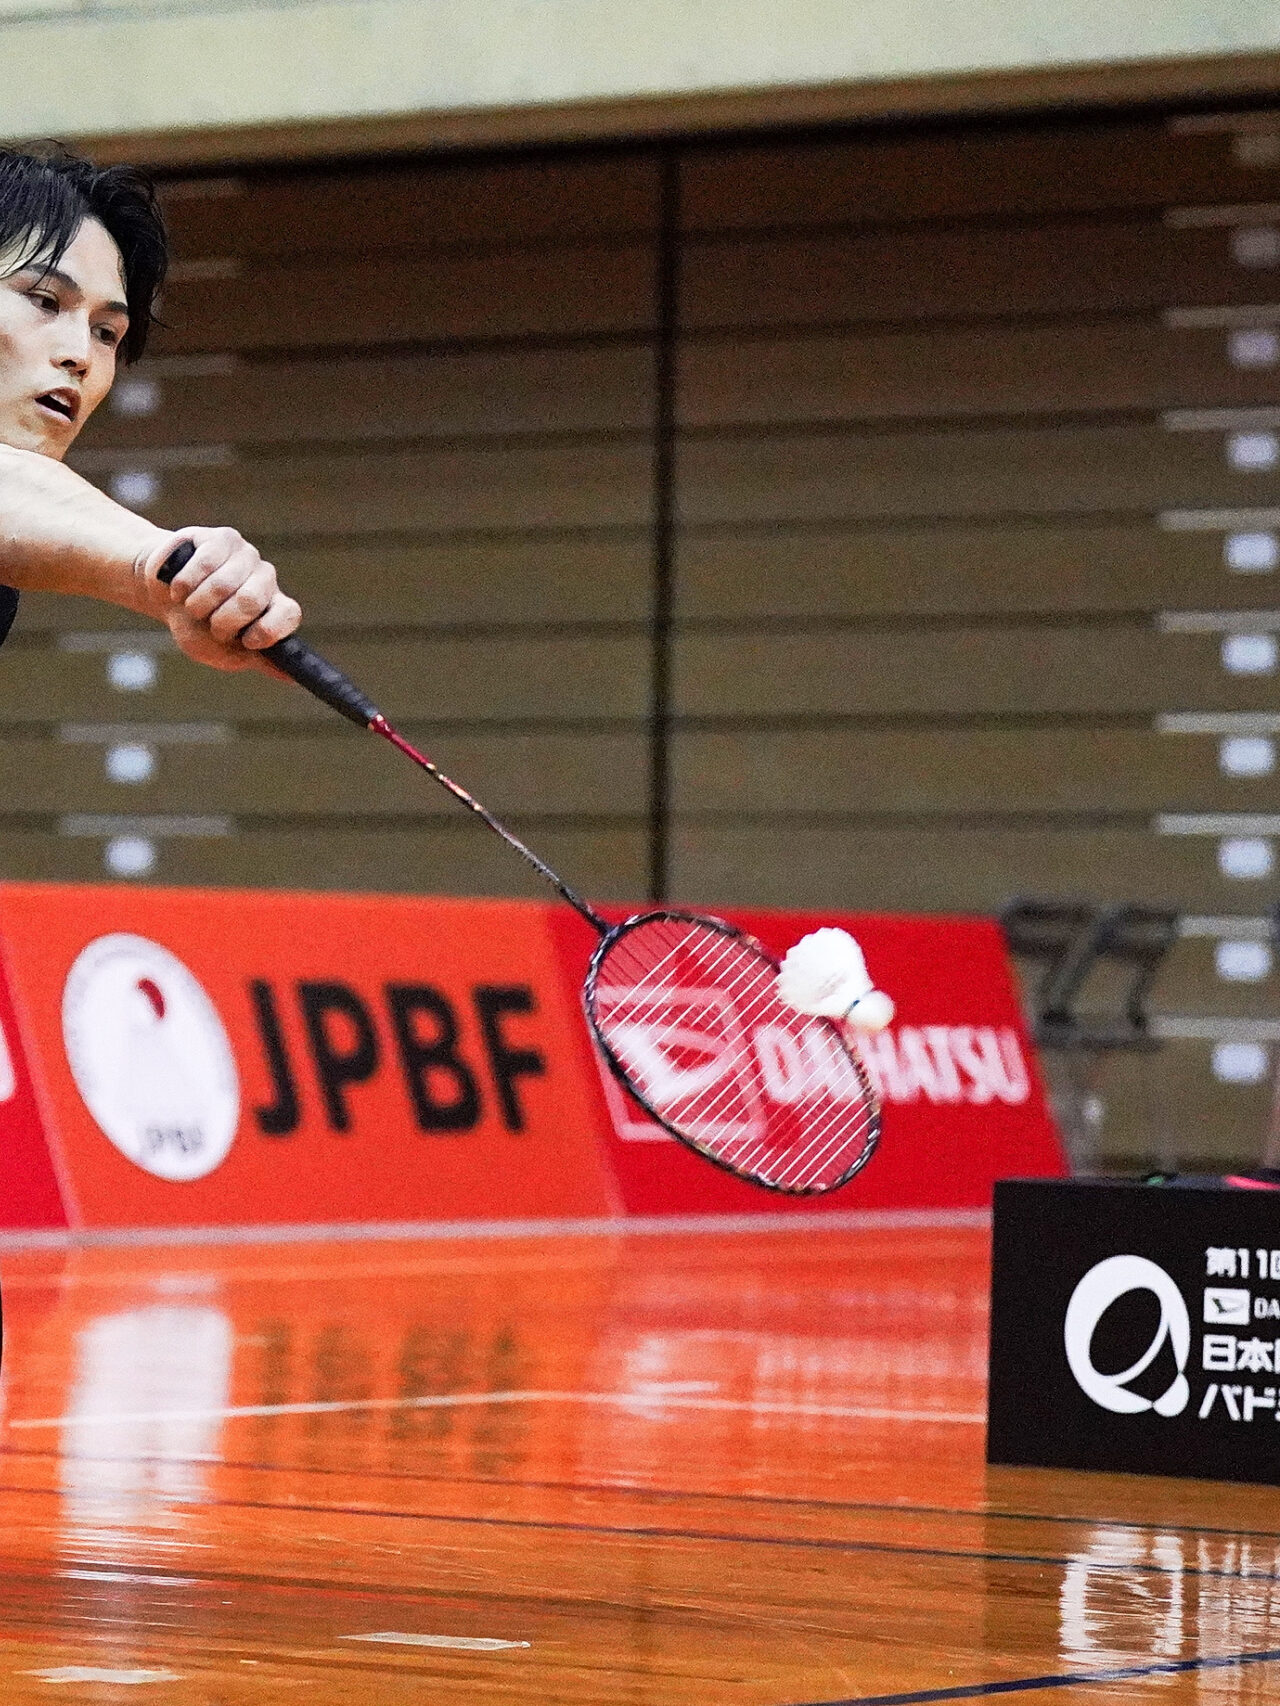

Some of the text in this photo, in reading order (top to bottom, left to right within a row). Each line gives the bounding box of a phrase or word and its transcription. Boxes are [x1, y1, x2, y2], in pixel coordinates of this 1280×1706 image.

[248, 977, 546, 1136] JPBF
[1202, 1334, 1280, 1374] 日本
[1198, 1383, 1280, 1422] バド
